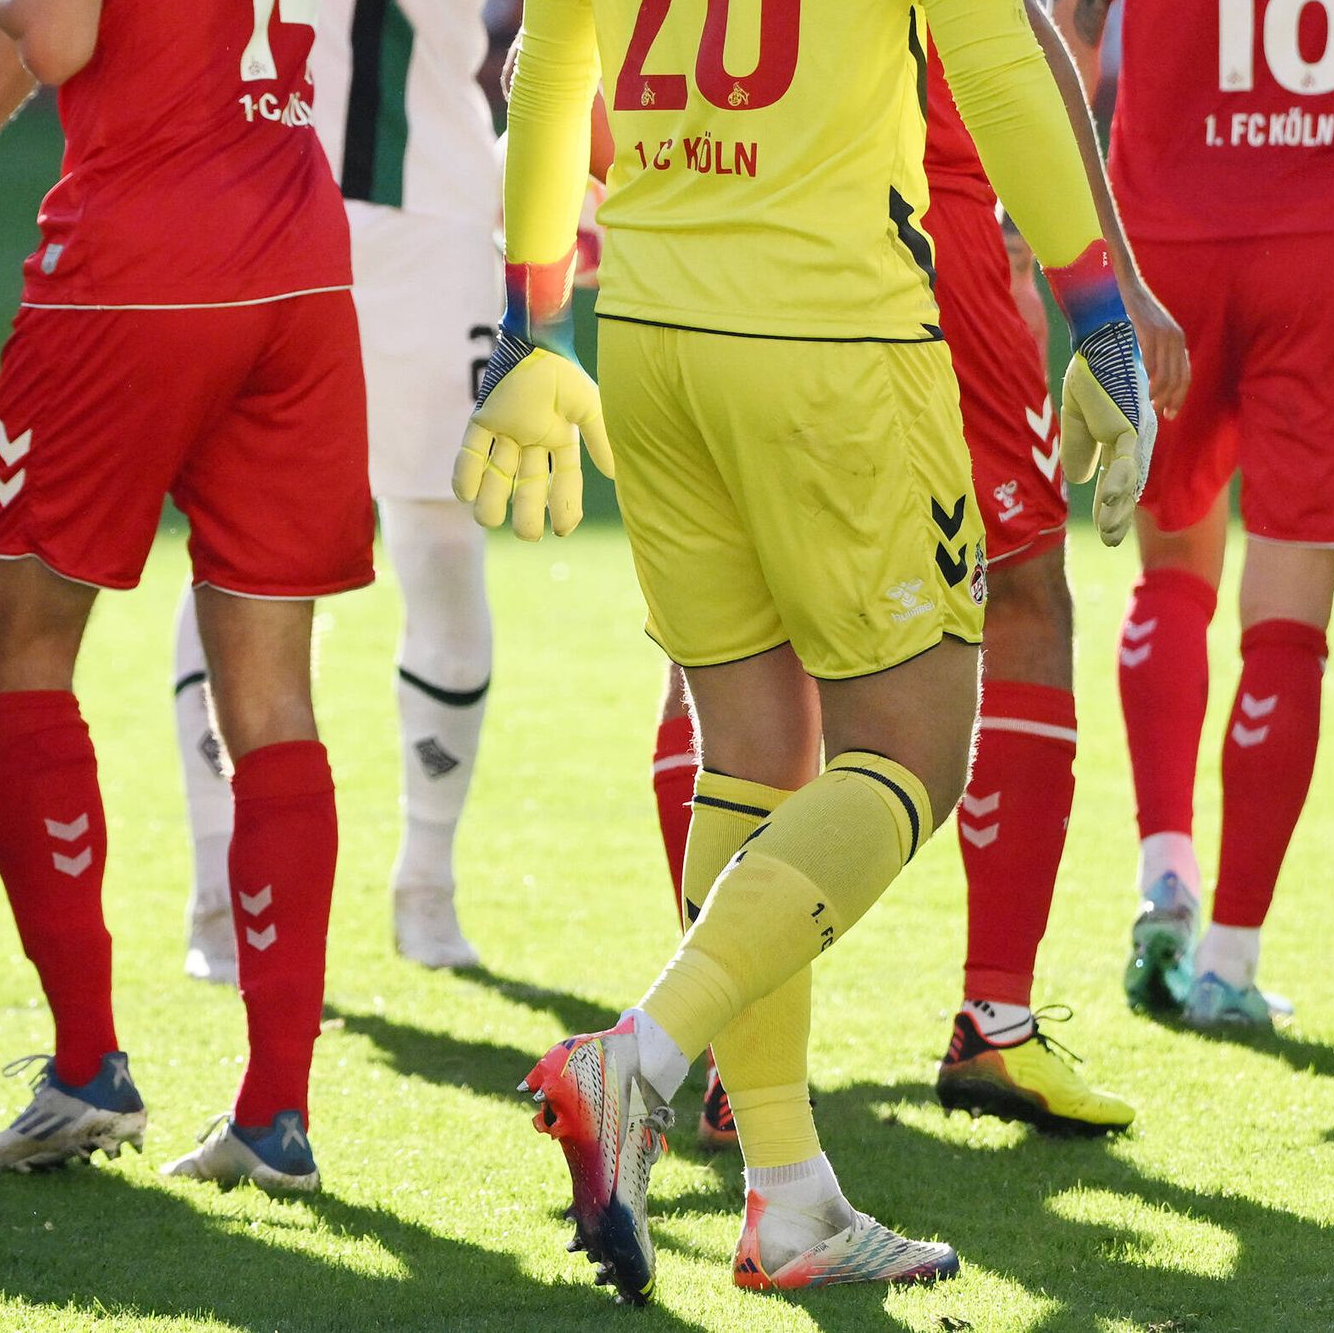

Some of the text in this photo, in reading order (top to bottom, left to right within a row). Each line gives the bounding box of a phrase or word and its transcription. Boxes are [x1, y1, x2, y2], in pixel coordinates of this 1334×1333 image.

[1205, 114, 1224, 146] 1.
[1230, 114, 1267, 147] FC
[682, 130, 758, 178] KÖLN
